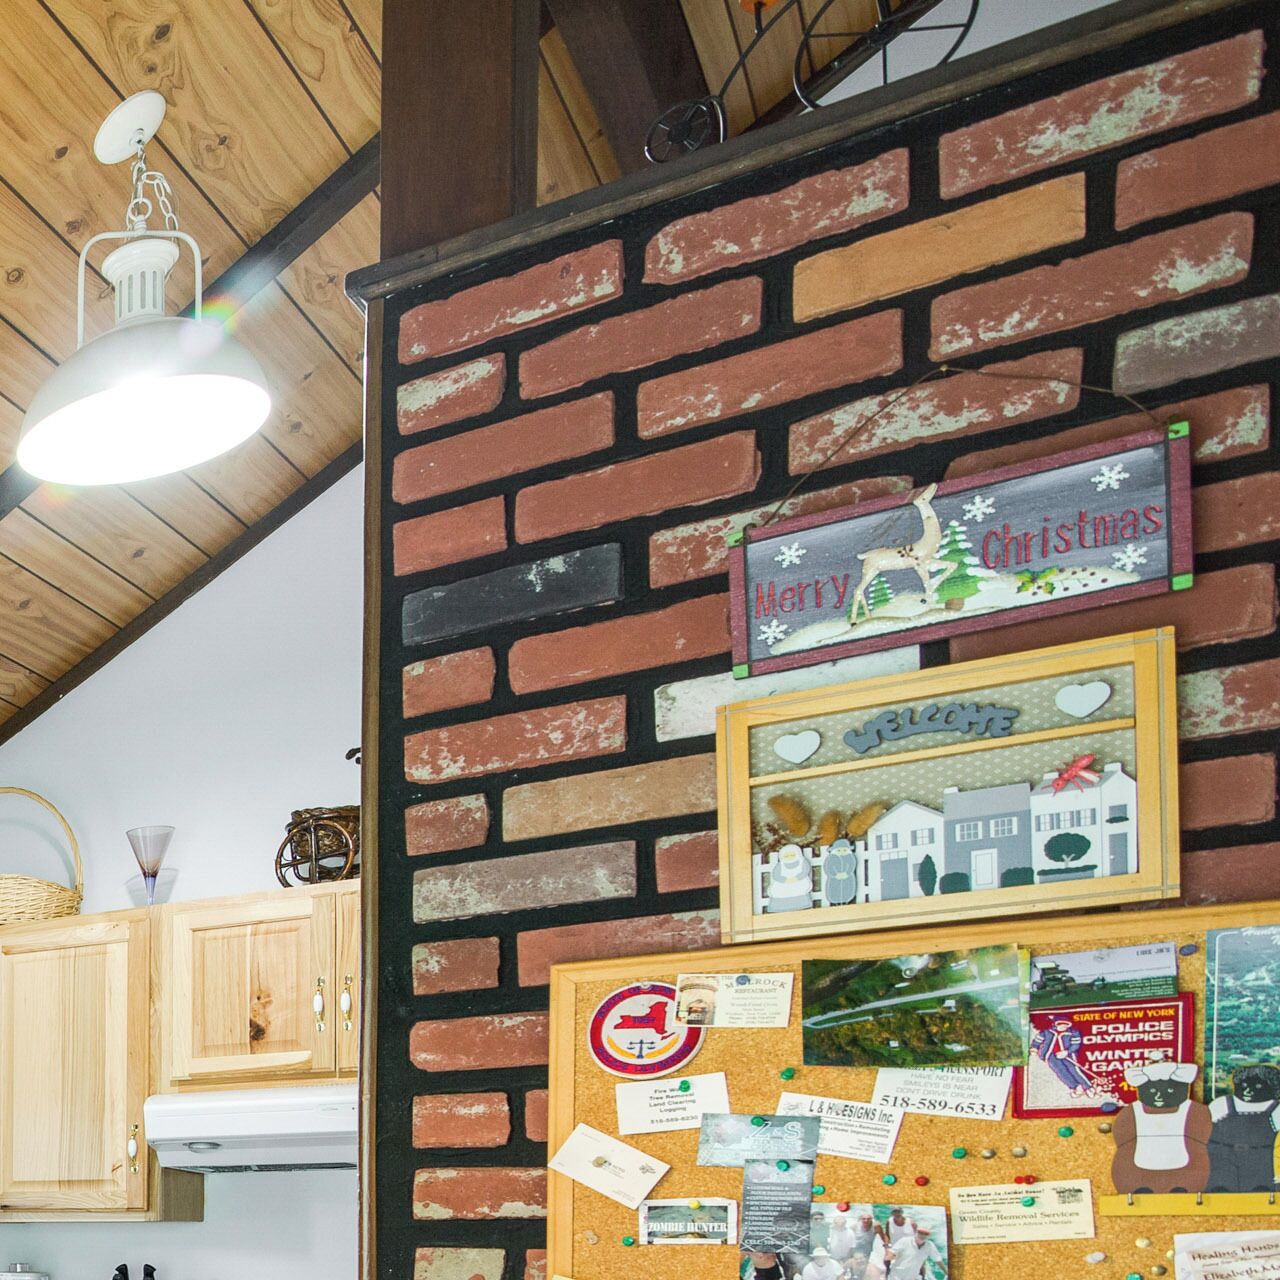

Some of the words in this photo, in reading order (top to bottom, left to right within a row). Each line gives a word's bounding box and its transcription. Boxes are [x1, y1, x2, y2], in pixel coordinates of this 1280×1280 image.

[982, 503, 1163, 570] Christmas
[754, 572, 850, 619] Merry
[844, 703, 1020, 754] WELCOME
[1241, 925, 1280, 937] Hunte
[1073, 1012, 1101, 1021] STATE
[1147, 1008, 1175, 1017] YORK
[1092, 1021, 1174, 1034] POLICE
[1083, 1032, 1173, 1044] OLYMPICS
[1092, 1059, 1153, 1072] GAM
[949, 1092, 981, 1100] DRUNK
[809, 1100, 814, 1112] L
[817, 1101, 824, 1113] &
[826, 1103, 833, 1114] H
[878, 1109, 894, 1123] Inc.
[880, 1094, 996, 1116] 518-589-6533
[784, 1121, 802, 1139] S
[648, 1223, 685, 1232] ZOMBIE
[688, 1222, 727, 1232] HUNTER
[1192, 1250, 1238, 1261] Healing
[1241, 1243, 1279, 1253] Hands
[1203, 1268, 1258, 1280] Elizabeth
